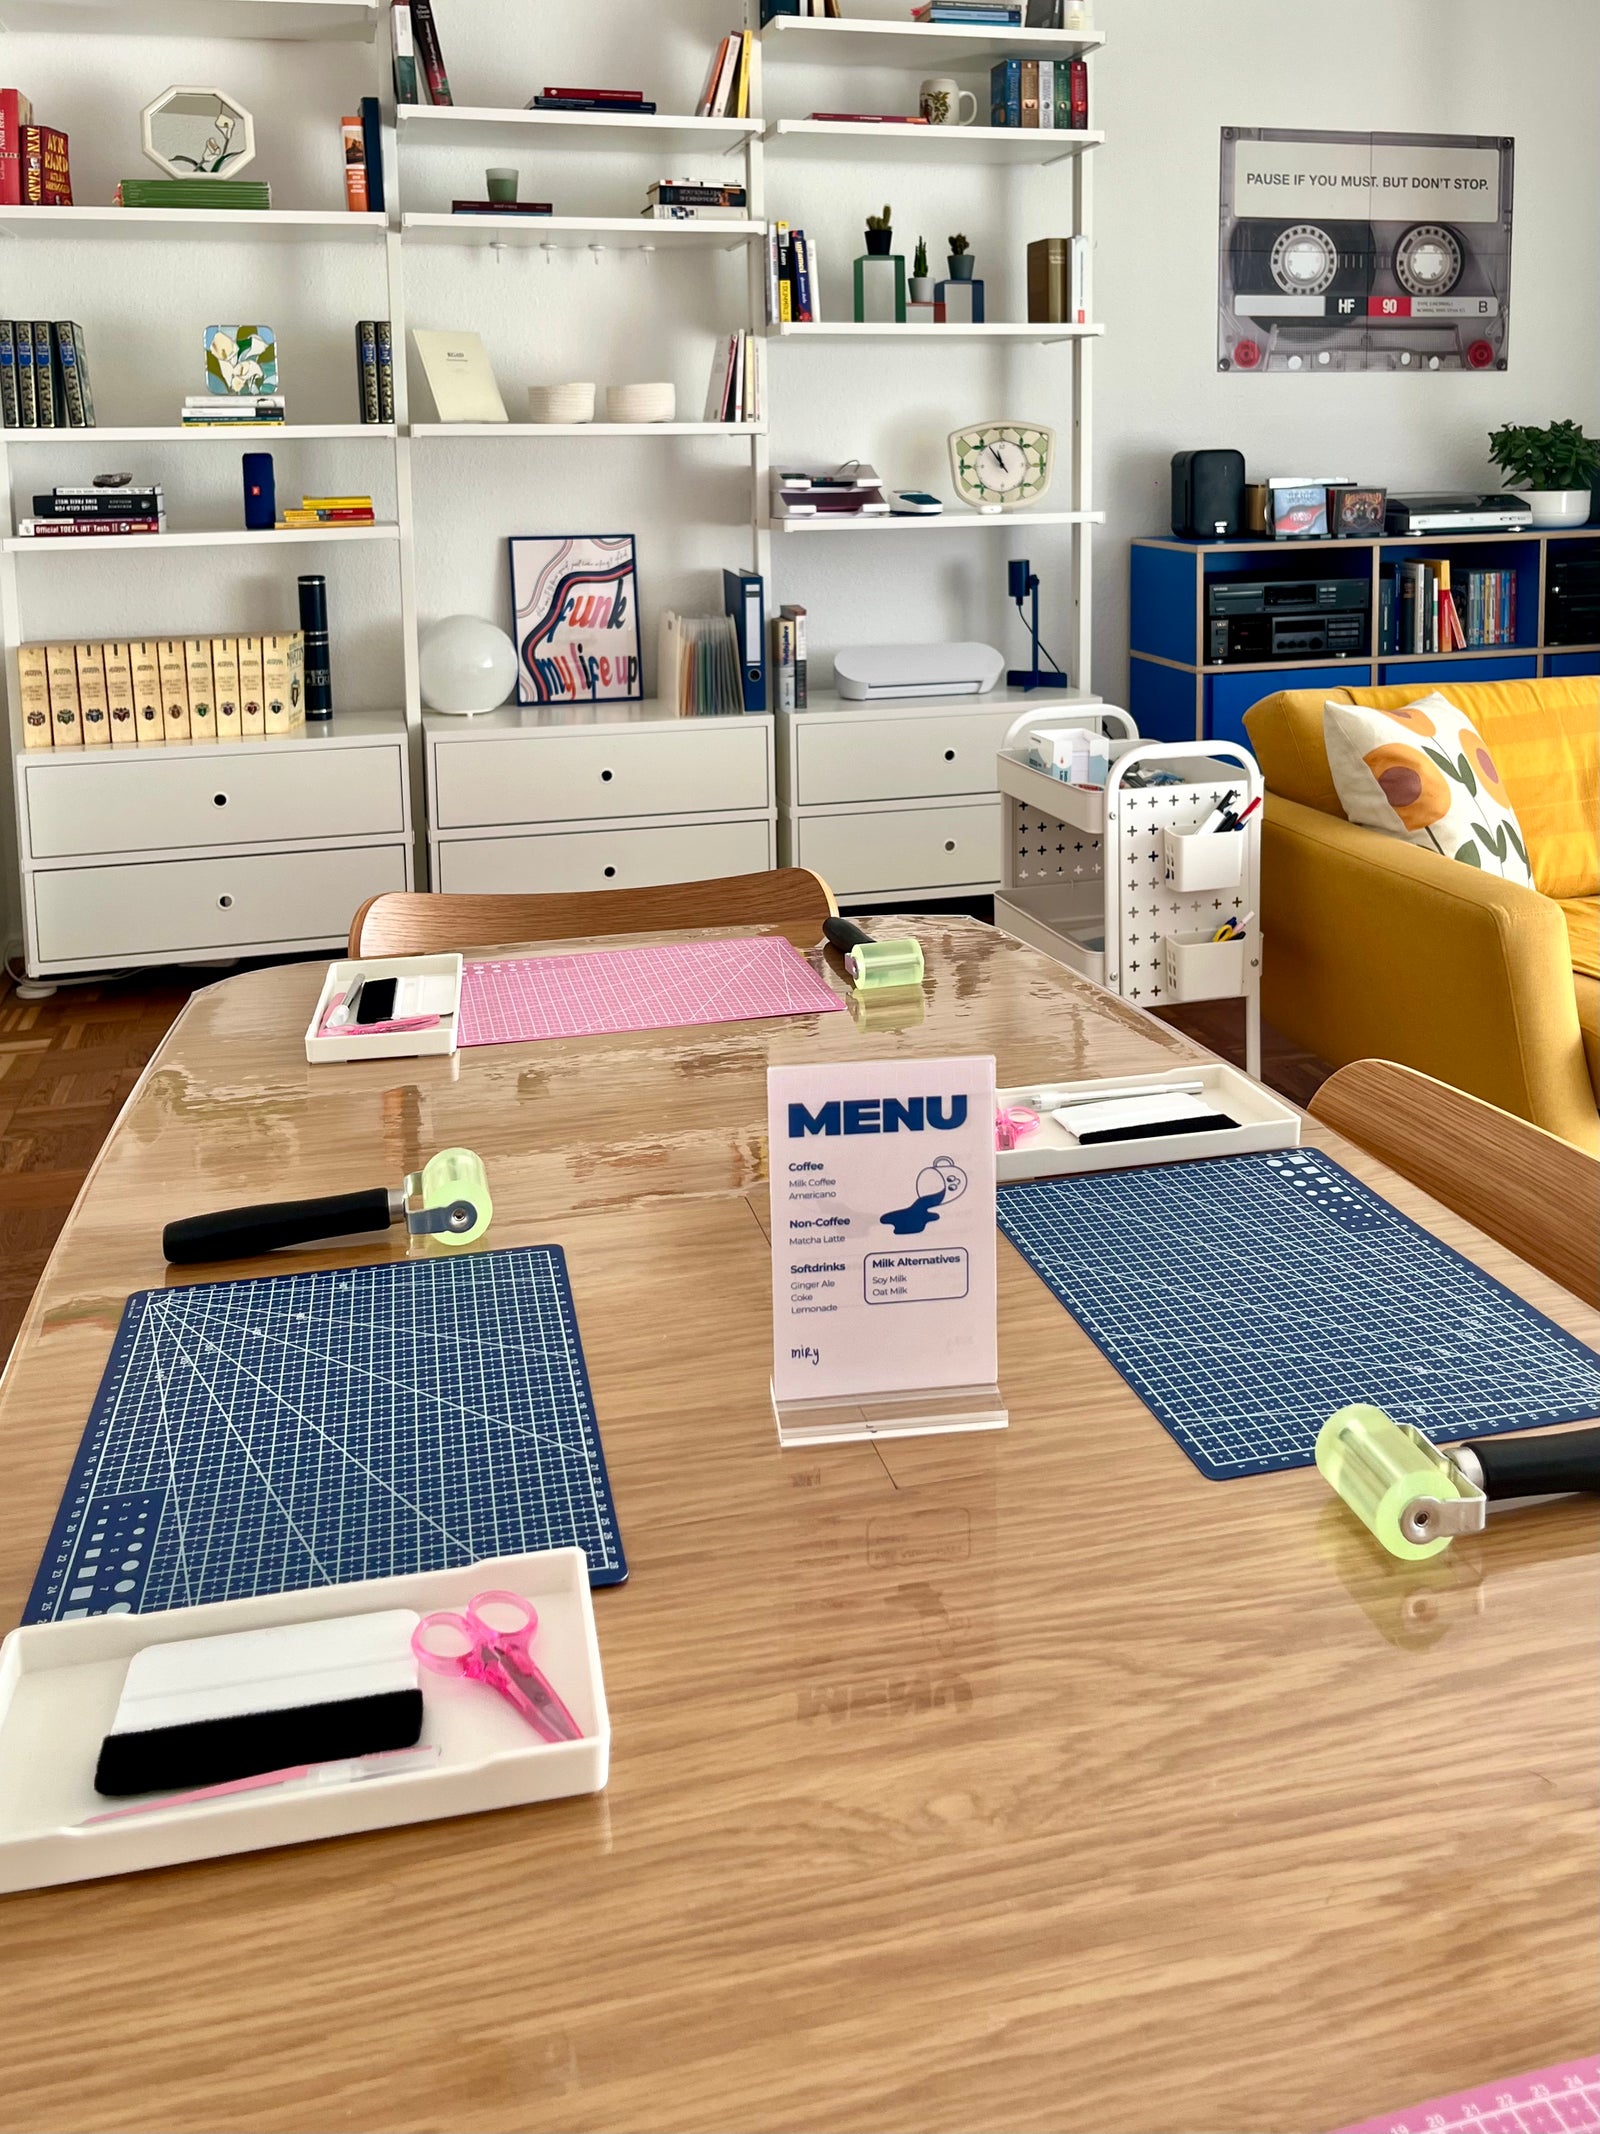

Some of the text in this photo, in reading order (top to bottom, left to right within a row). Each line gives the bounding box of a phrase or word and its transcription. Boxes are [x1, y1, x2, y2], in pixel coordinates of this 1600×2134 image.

[48, 134, 65, 154] AYN
[28, 168, 40, 201] RAND
[1246, 173, 1488, 190] PAUSE IF YOU MUST. BUT DON'T STOP.
[1338, 299, 1355, 314] HF
[1382, 298, 1398, 314] 90
[1478, 300, 1488, 314] B
[36, 524, 58, 534] Official
[60, 523, 79, 533] TOEFL
[94, 522, 110, 532] Tests
[547, 577, 627, 643] funk
[536, 643, 638, 700] my life up
[788, 1094, 968, 1138] MENU
[788, 1162, 824, 1172] Coffee
[789, 1178, 836, 1188] Milk Coffee
[788, 1190, 836, 1200] Americano
[790, 1216, 850, 1228] Non-Coffee
[790, 1235, 846, 1246] Matcha Latte
[872, 1254, 960, 1268] Milk Alternatives
[790, 1262, 846, 1274] Softdrinks
[872, 1274, 907, 1285] Soy Milk
[790, 1280, 836, 1291] Ginger Ale
[872, 1286, 908, 1296] Oat Milk
[791, 1294, 814, 1302] Coke
[791, 1304, 838, 1314] Lemonade
[66, 1524, 77, 1533] 20
[62, 1539, 72, 1548] 21
[56, 1554, 68, 1562] 22
[52, 1569, 63, 1579] 23
[46, 1585, 58, 1595] 24
[42, 1601, 53, 1612] 25
[1425, 2114, 1446, 2128] 20
[1461, 2103, 1482, 2118] 21
[1495, 2094, 1514, 2108] 22
[1529, 2084, 1550, 2099] 23
[1563, 2074, 1584, 2090] 24
